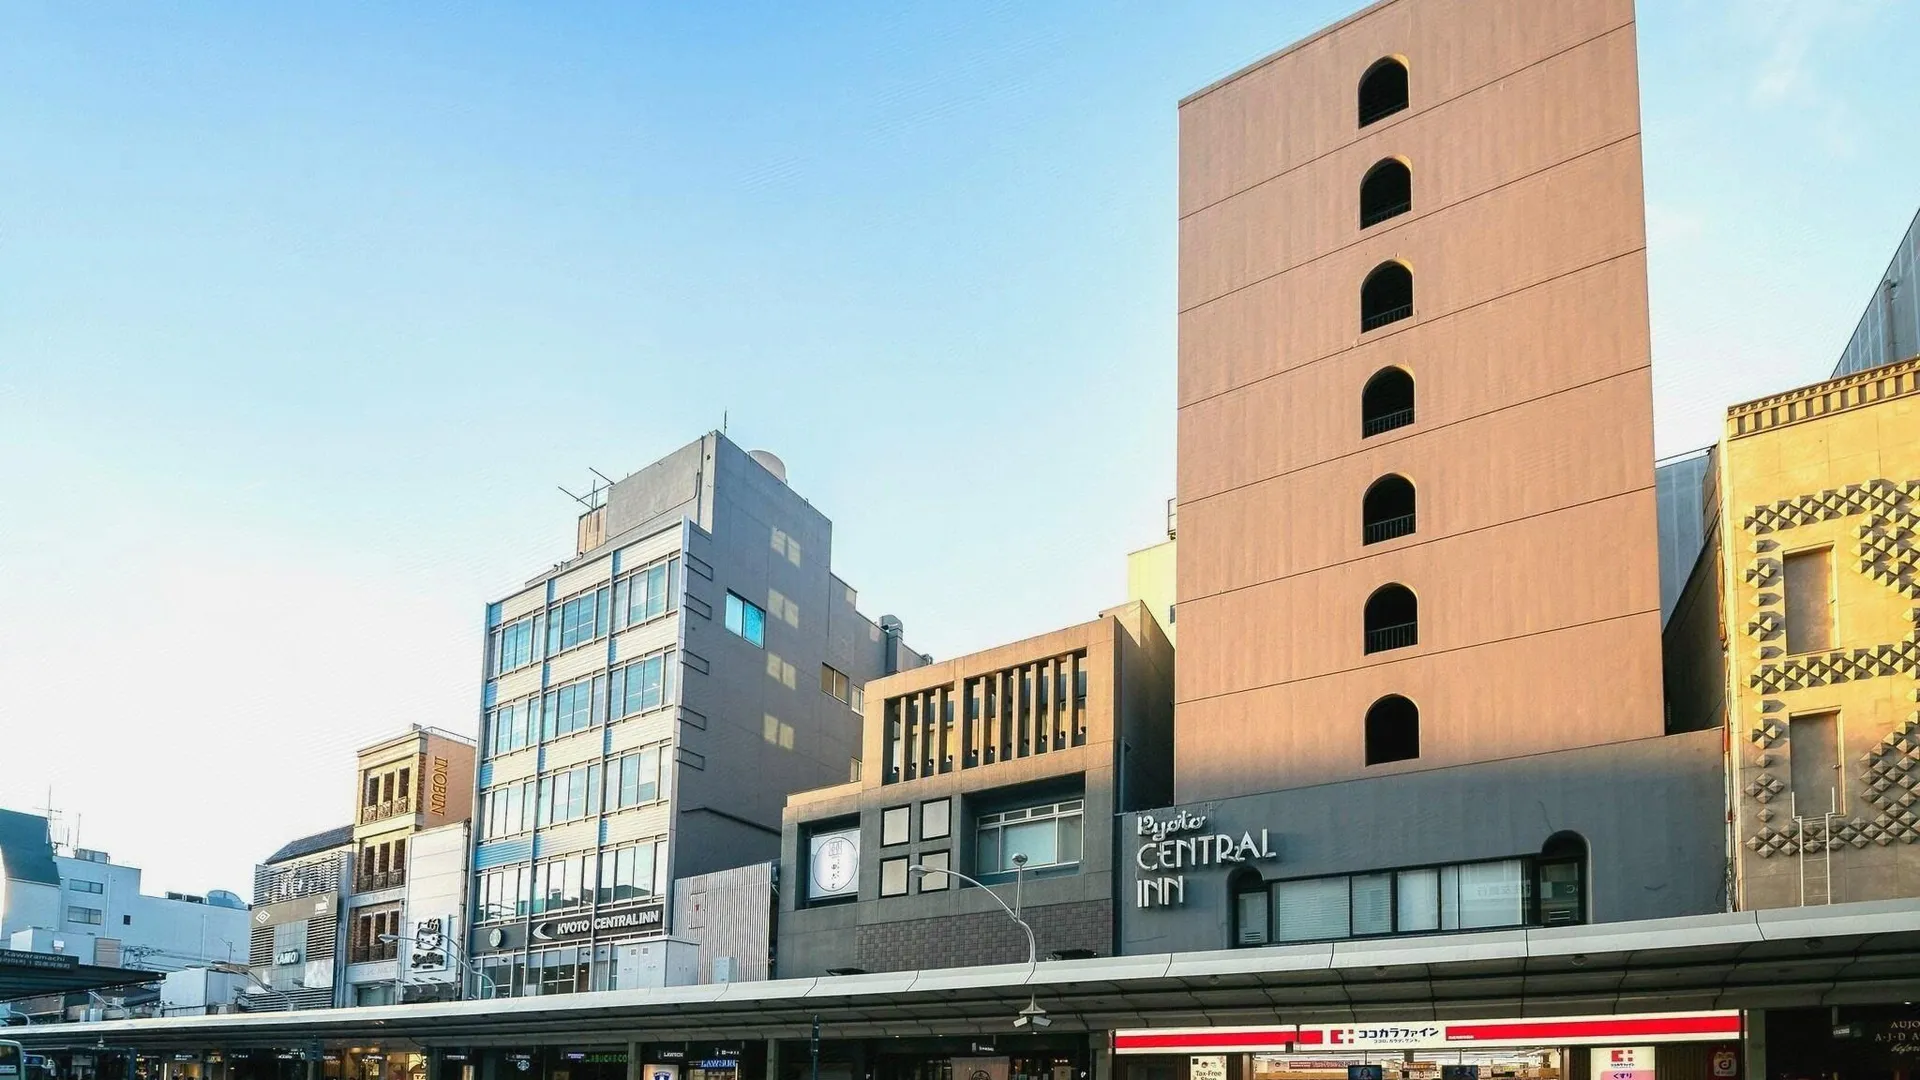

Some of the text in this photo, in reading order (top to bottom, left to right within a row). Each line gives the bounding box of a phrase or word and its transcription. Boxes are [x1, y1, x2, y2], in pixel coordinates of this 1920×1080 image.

[431, 755, 448, 816] INOBUN
[1136, 828, 1277, 871] CENTRAL
[1137, 875, 1184, 908] INN
[557, 910, 659, 935] KYOTO CENTRAL INN
[4, 951, 66, 962] Kawaramachi
[1358, 1027, 1439, 1039] ココカラファイン
